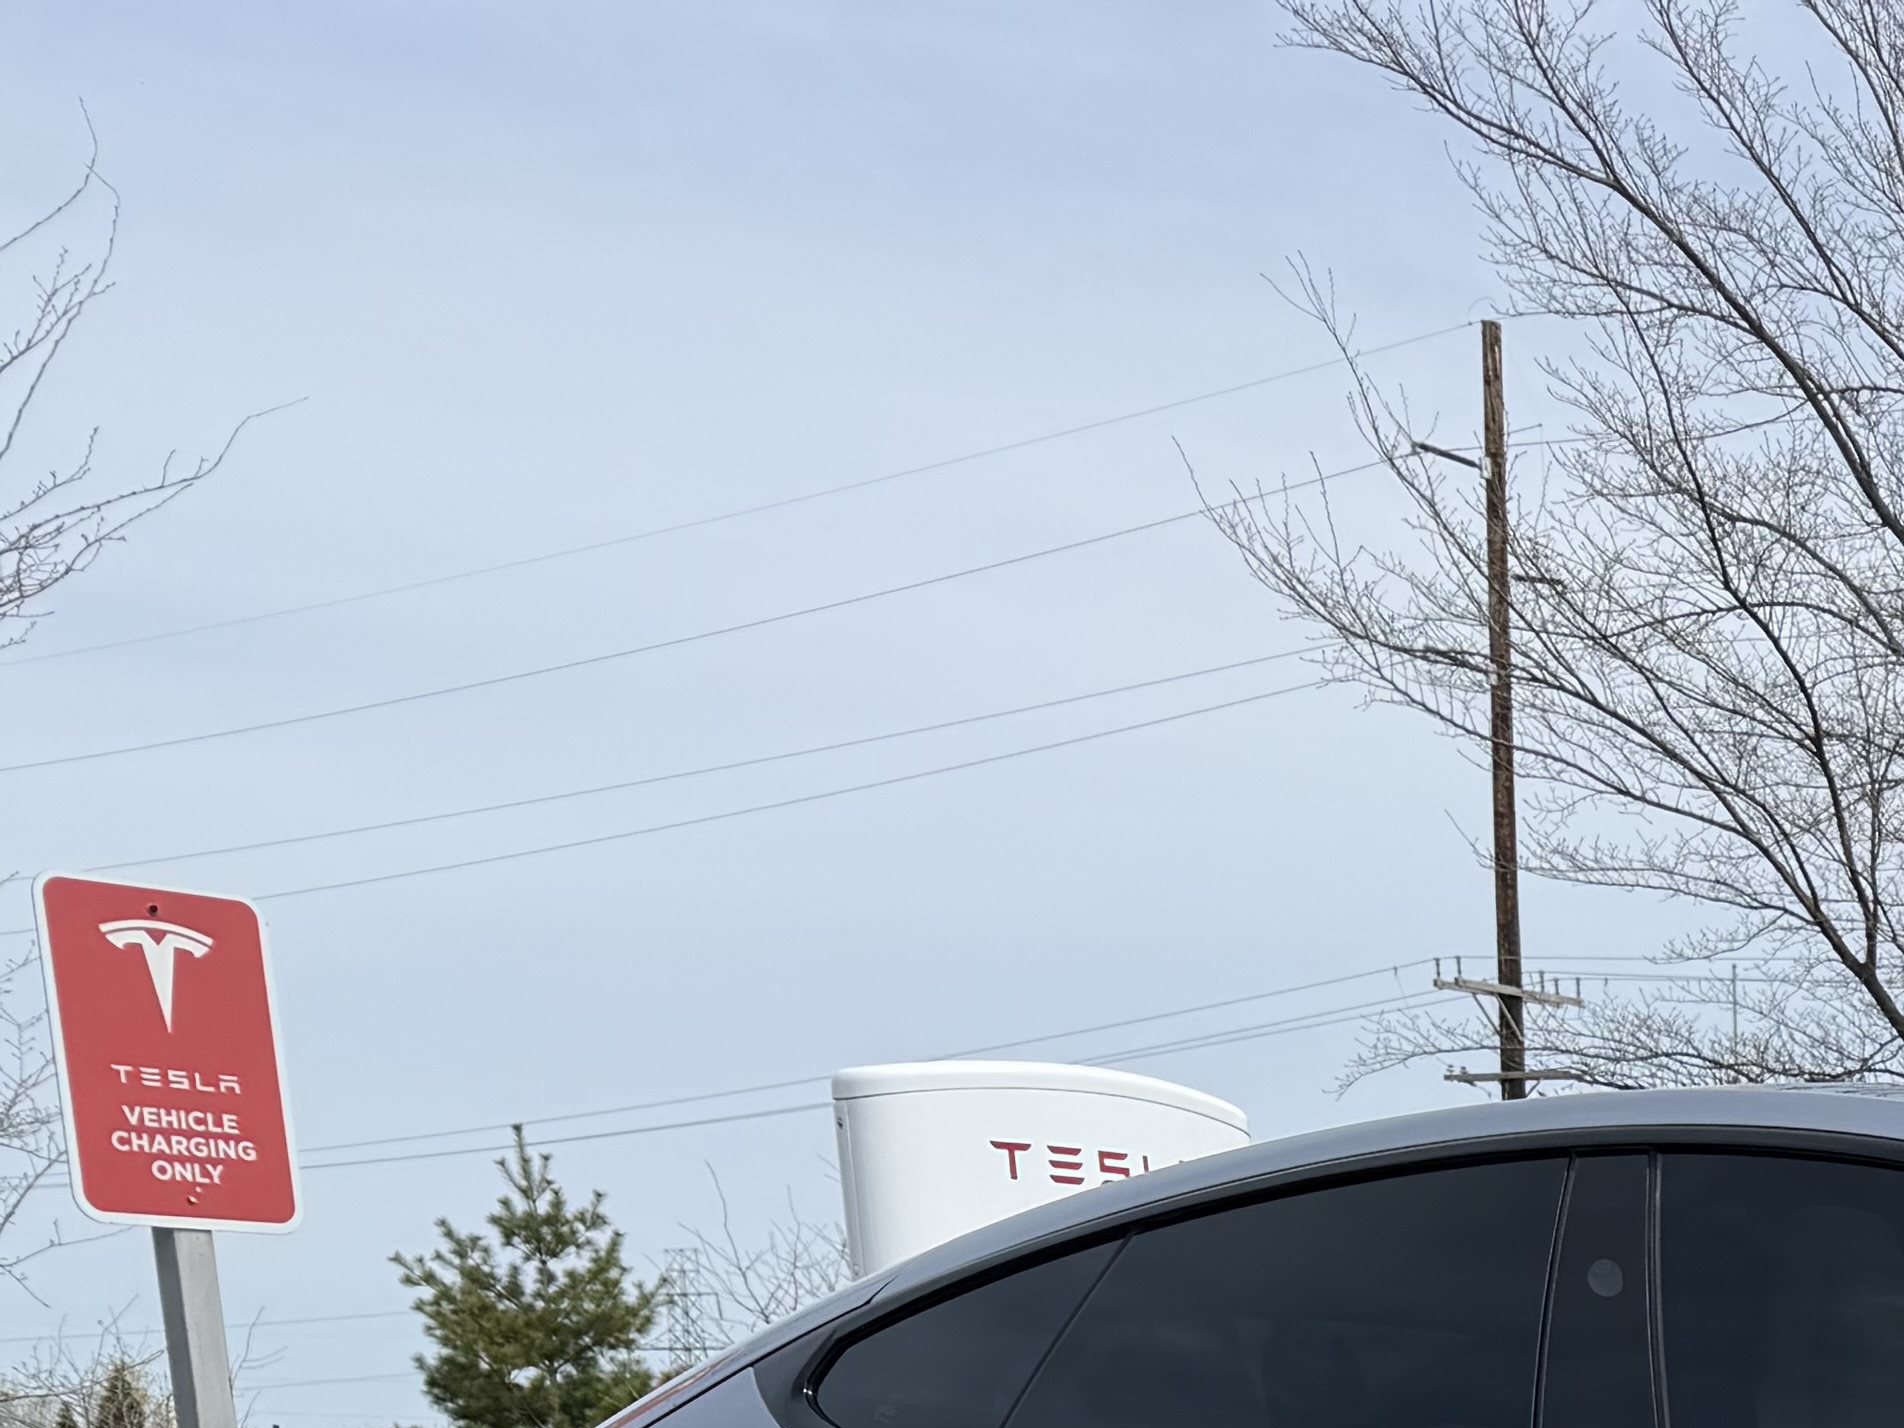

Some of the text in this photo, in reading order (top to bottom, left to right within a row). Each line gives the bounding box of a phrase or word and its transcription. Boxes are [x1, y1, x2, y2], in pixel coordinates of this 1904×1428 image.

[111, 1063, 241, 1095] TESLA
[122, 1105, 240, 1135] VEHICLE
[111, 1130, 257, 1162] CHARGING
[151, 1160, 224, 1185] ONLY
[989, 1140, 1187, 1186] TES
